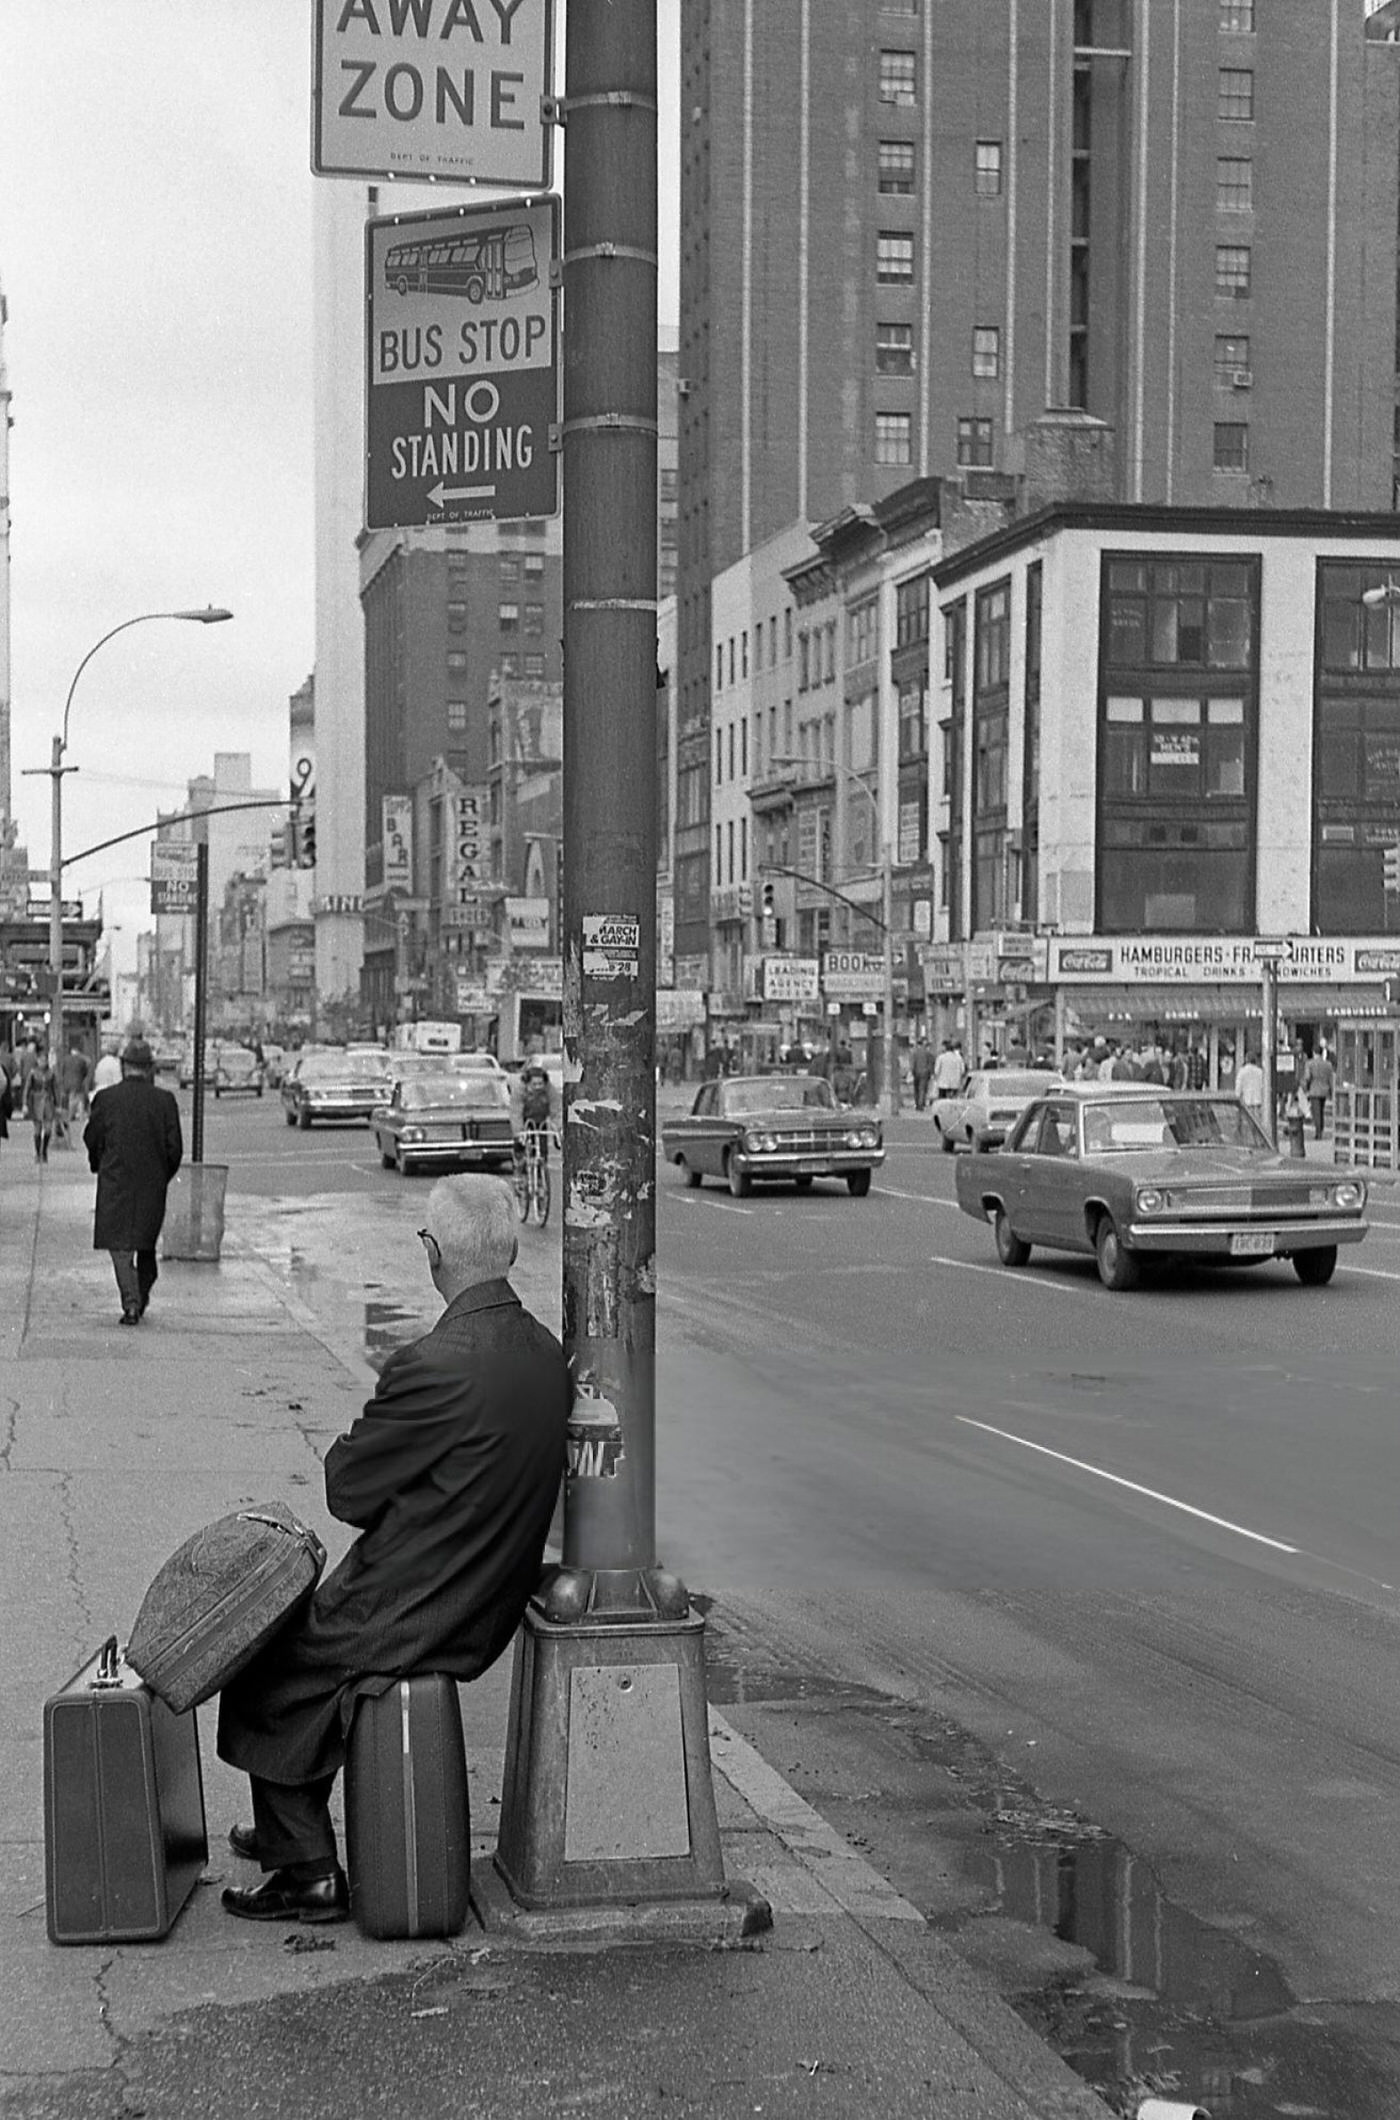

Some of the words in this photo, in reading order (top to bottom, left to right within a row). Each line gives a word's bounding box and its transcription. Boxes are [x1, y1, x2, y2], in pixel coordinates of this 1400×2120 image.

[336, 0, 524, 45] AWAY
[338, 60, 525, 130] ZONE
[379, 324, 443, 374] BUS
[459, 314, 546, 364] STOP
[424, 380, 500, 428] NO
[391, 425, 533, 479] STANDING
[427, 512, 446, 521] DEPT
[449, 511, 459, 519] OF
[386, 817, 408, 863] BAR
[459, 797, 479, 905] REGAL
[166, 880, 190, 893] NO
[590, 934, 599, 945] &
[601, 935, 637, 946] GAY-IN
[599, 926, 637, 936] MARCH
[618, 961, 631, 973] 28
[1121, 945, 1223, 964] HAMBURGERS
[1233, 945, 1345, 964] FRURTERS
[1134, 966, 1187, 977] TROPICAL
[1203, 966, 1246, 977] DRINKS
